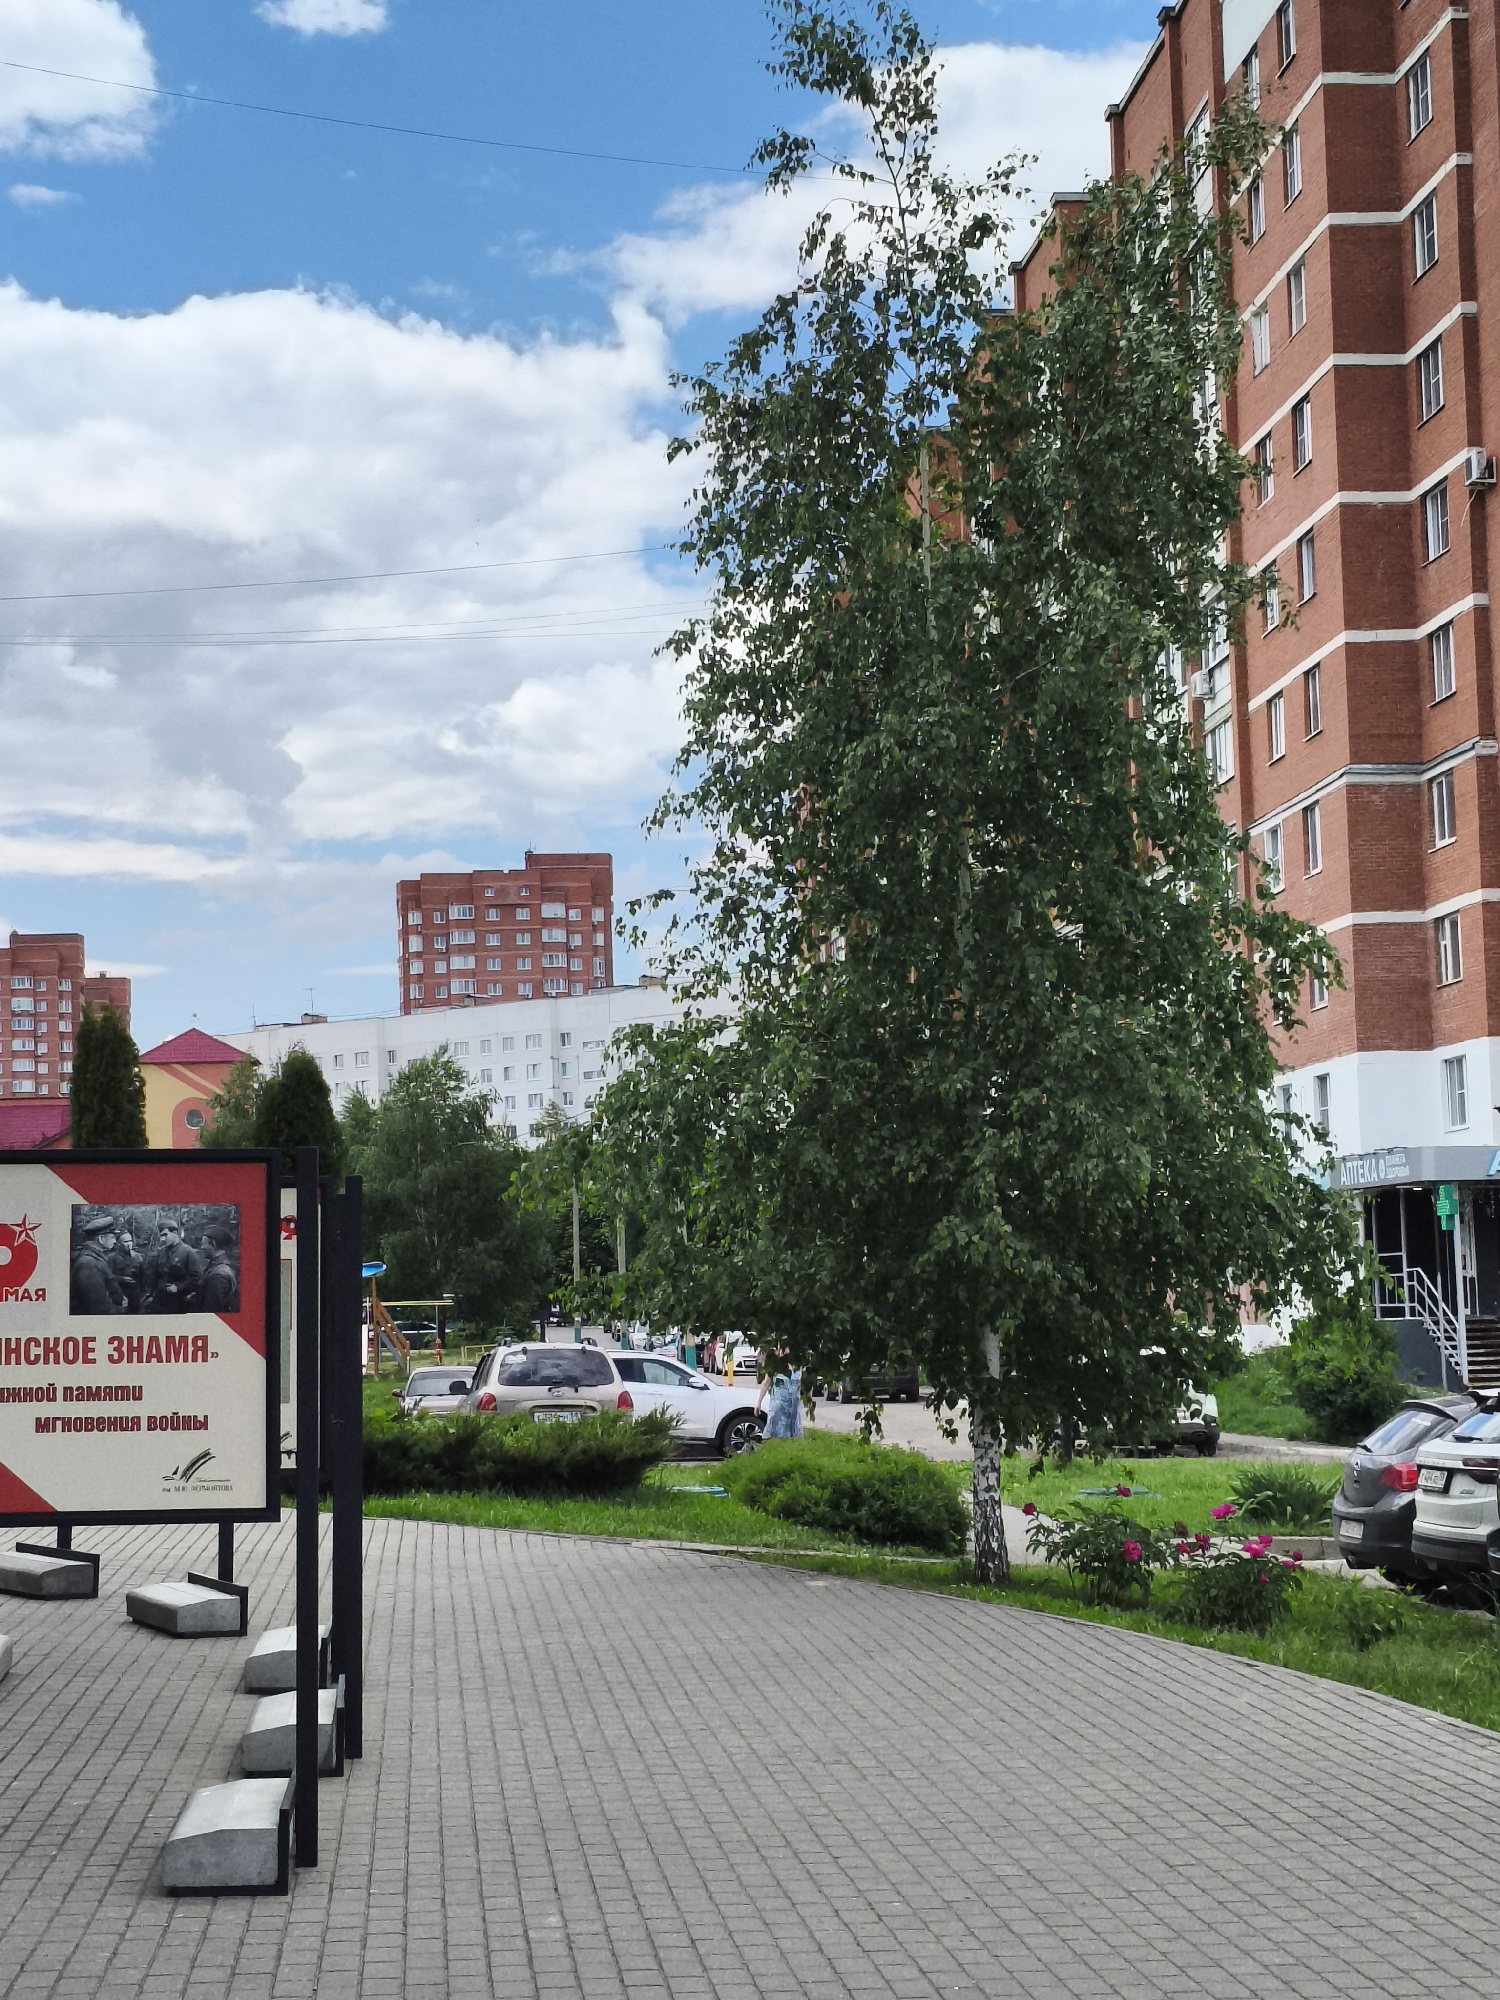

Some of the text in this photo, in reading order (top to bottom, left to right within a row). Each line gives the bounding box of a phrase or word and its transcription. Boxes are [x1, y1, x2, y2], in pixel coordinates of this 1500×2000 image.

[1340, 1159, 1378, 1186] АПТЕКА
[4, 1288, 47, 1302] МАЯ
[107, 1334, 219, 1364] ЗНАМЯ»
[62, 1385, 143, 1402] памяти
[35, 1412, 209, 1433] мгновения войны
